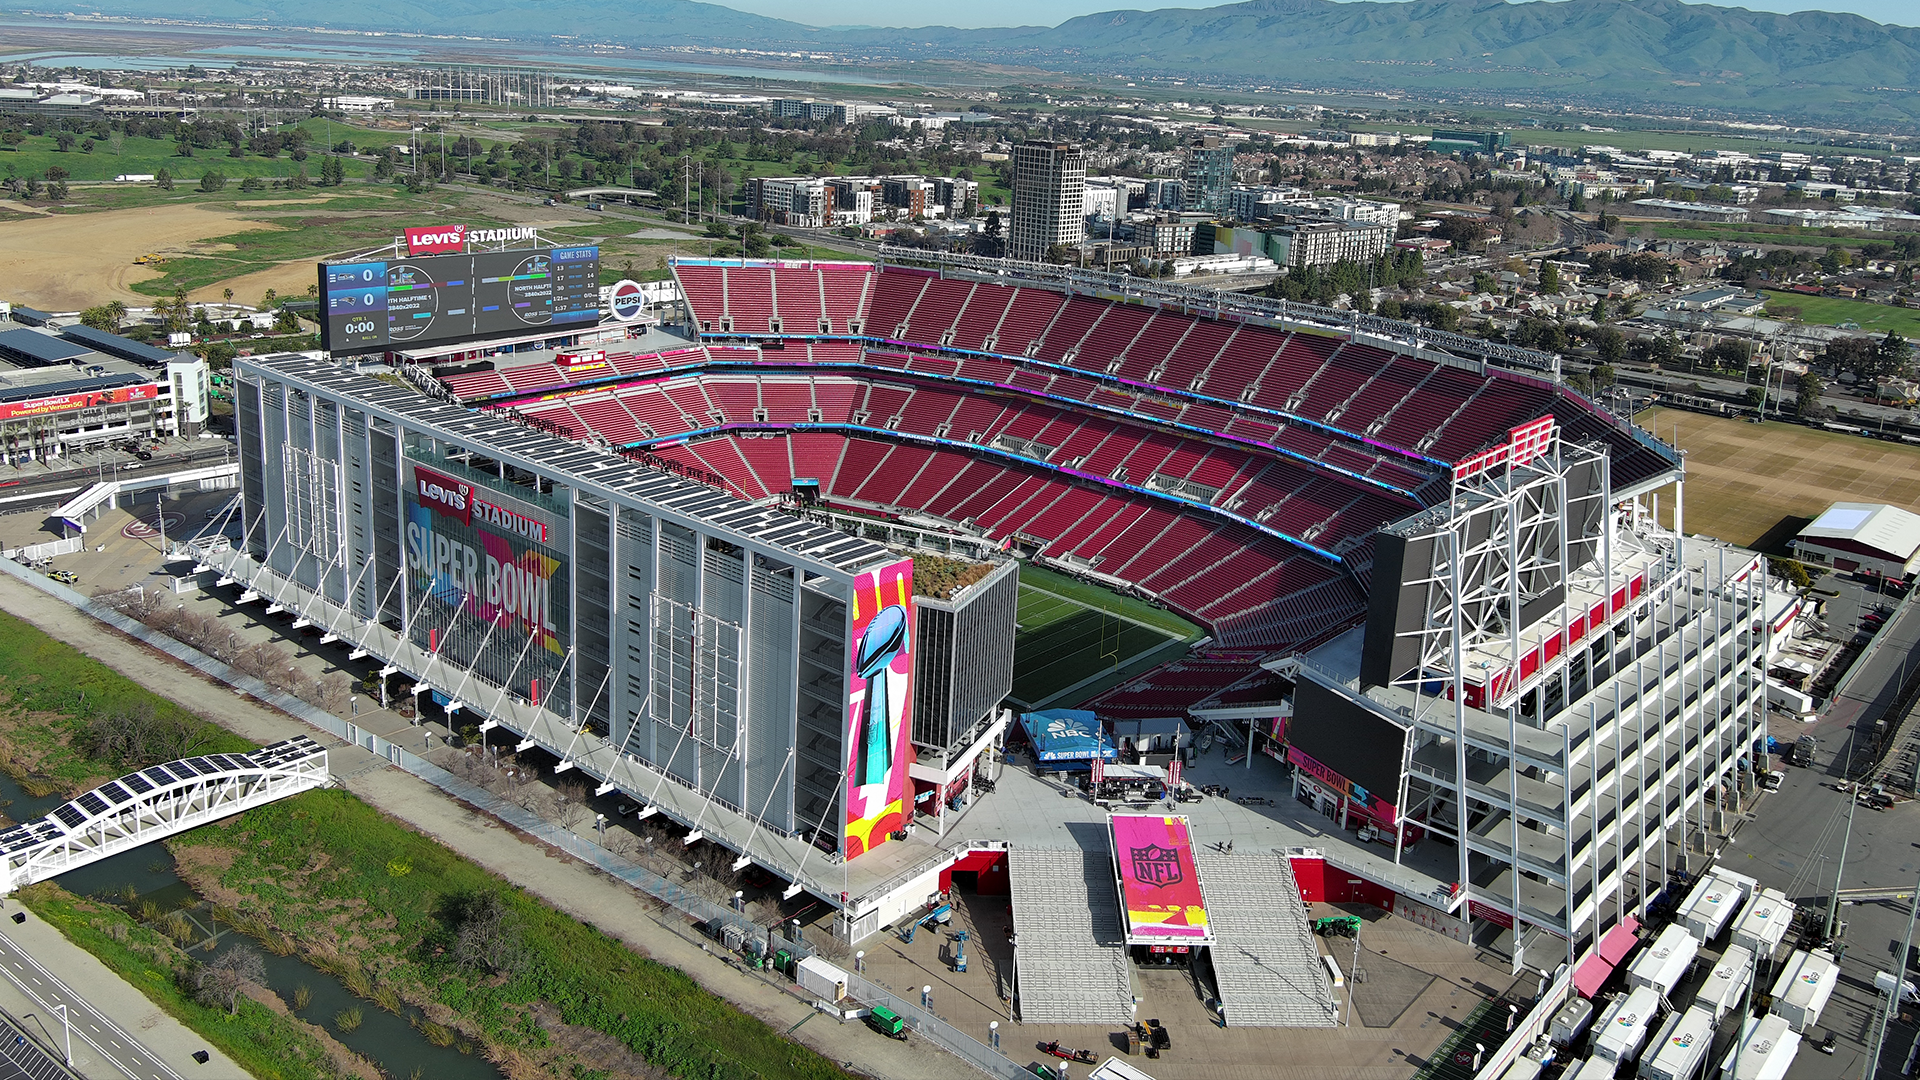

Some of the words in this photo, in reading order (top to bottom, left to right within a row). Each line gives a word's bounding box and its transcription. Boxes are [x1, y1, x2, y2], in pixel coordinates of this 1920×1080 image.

[470, 227, 536, 243] STADIUM
[560, 251, 575, 260] GAME
[575, 250, 592, 259] STATS
[362, 269, 373, 281] 0
[363, 293, 374, 305] 0
[615, 296, 641, 305] PEPSI
[345, 321, 375, 334] 0:00
[11, 407, 40, 416] Powered
[49, 403, 73, 411] Verizon
[23, 401, 43, 409] Super
[44, 398, 60, 406] Bowl
[473, 500, 546, 543] STADIUM
[407, 521, 479, 597] SUPER
[486, 555, 557, 633] BOWL
[1051, 729, 1092, 739] NBC
[1057, 751, 1075, 759] SUPER
[1075, 751, 1090, 759] BOWL
[1302, 755, 1326, 780] SUPER
[1326, 769, 1348, 793] BOWL
[1137, 862, 1178, 883] NFL
